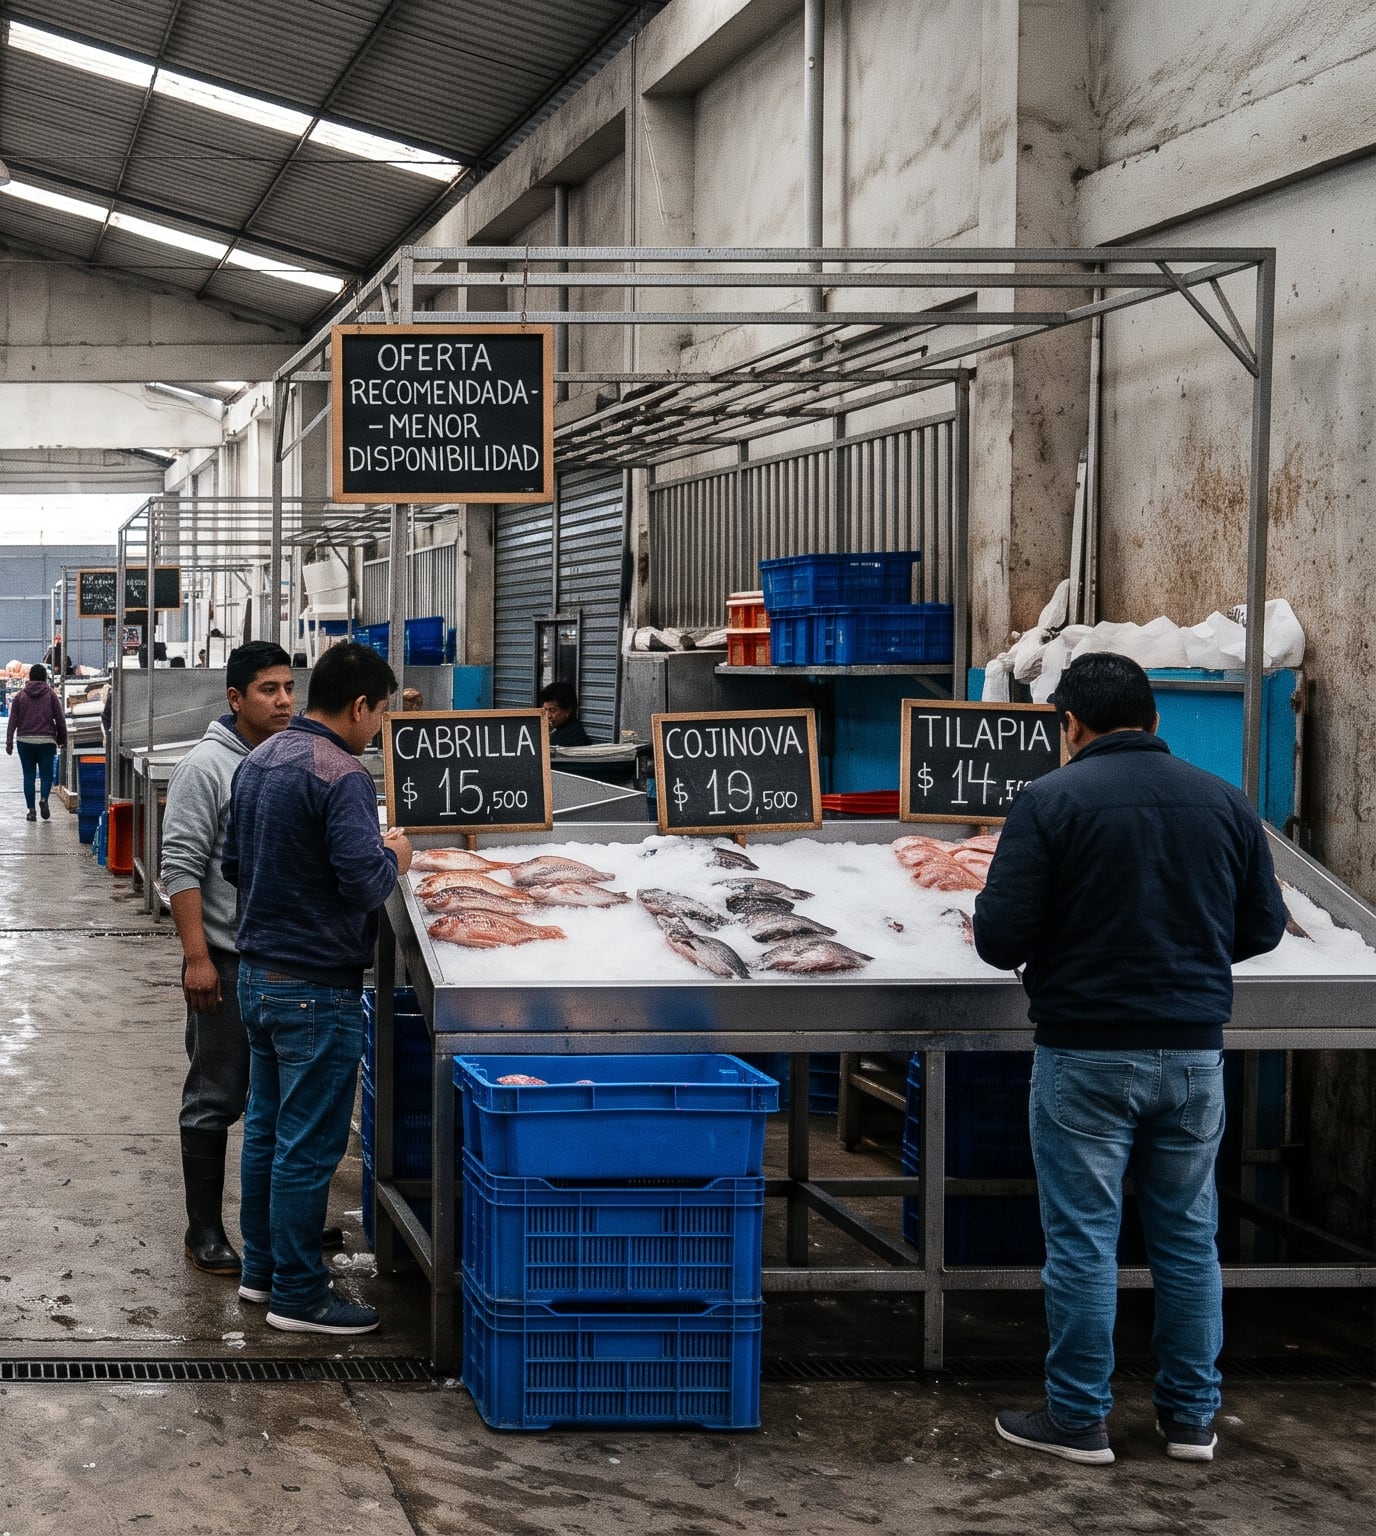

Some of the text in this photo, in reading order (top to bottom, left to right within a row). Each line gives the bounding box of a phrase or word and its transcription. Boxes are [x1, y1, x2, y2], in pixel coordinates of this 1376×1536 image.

[378, 343, 492, 371] OFERTA
[349, 445, 539, 472] DISPONIBILIDAD
[396, 725, 535, 759] CABRILLA
[666, 726, 803, 759] COJINOVA
[919, 715, 1051, 751] TILAPIA
[403, 768, 527, 815] $ 15,500
[673, 769, 797, 815] $ 19,500
[918, 762, 934, 796] $
